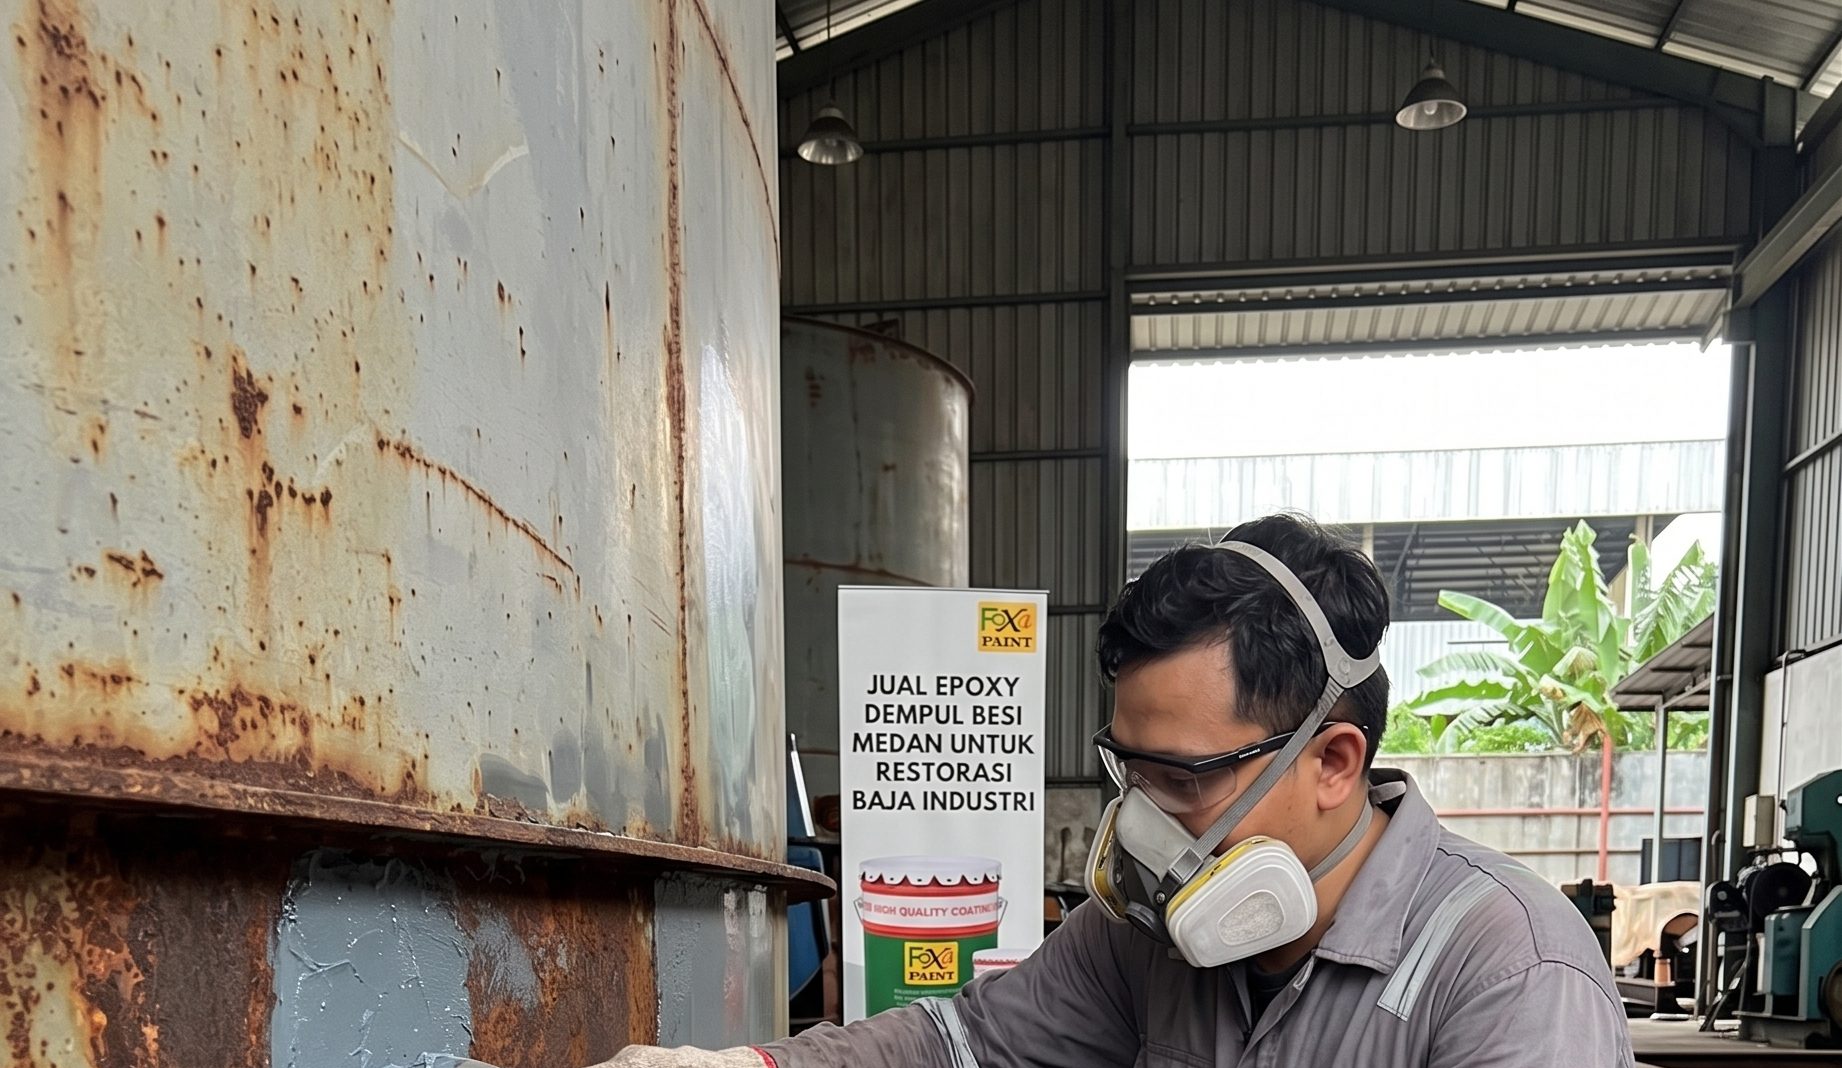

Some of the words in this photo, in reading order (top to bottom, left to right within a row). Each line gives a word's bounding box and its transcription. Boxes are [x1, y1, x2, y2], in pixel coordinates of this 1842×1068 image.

[982, 636, 1032, 647] PAINT
[867, 675, 927, 695] JUAL
[936, 676, 1020, 697] EPOXY
[865, 704, 964, 725] DEMPUL
[972, 706, 1022, 725] BESI
[852, 733, 942, 753] MEDAN
[951, 734, 1035, 754] UNTUK
[876, 762, 1012, 782] RESTORASI
[852, 790, 915, 811] BAJA
[923, 791, 1035, 811] INDUSTRI
[899, 906, 948, 917] QUALITY
[909, 971, 954, 980] PAINT
